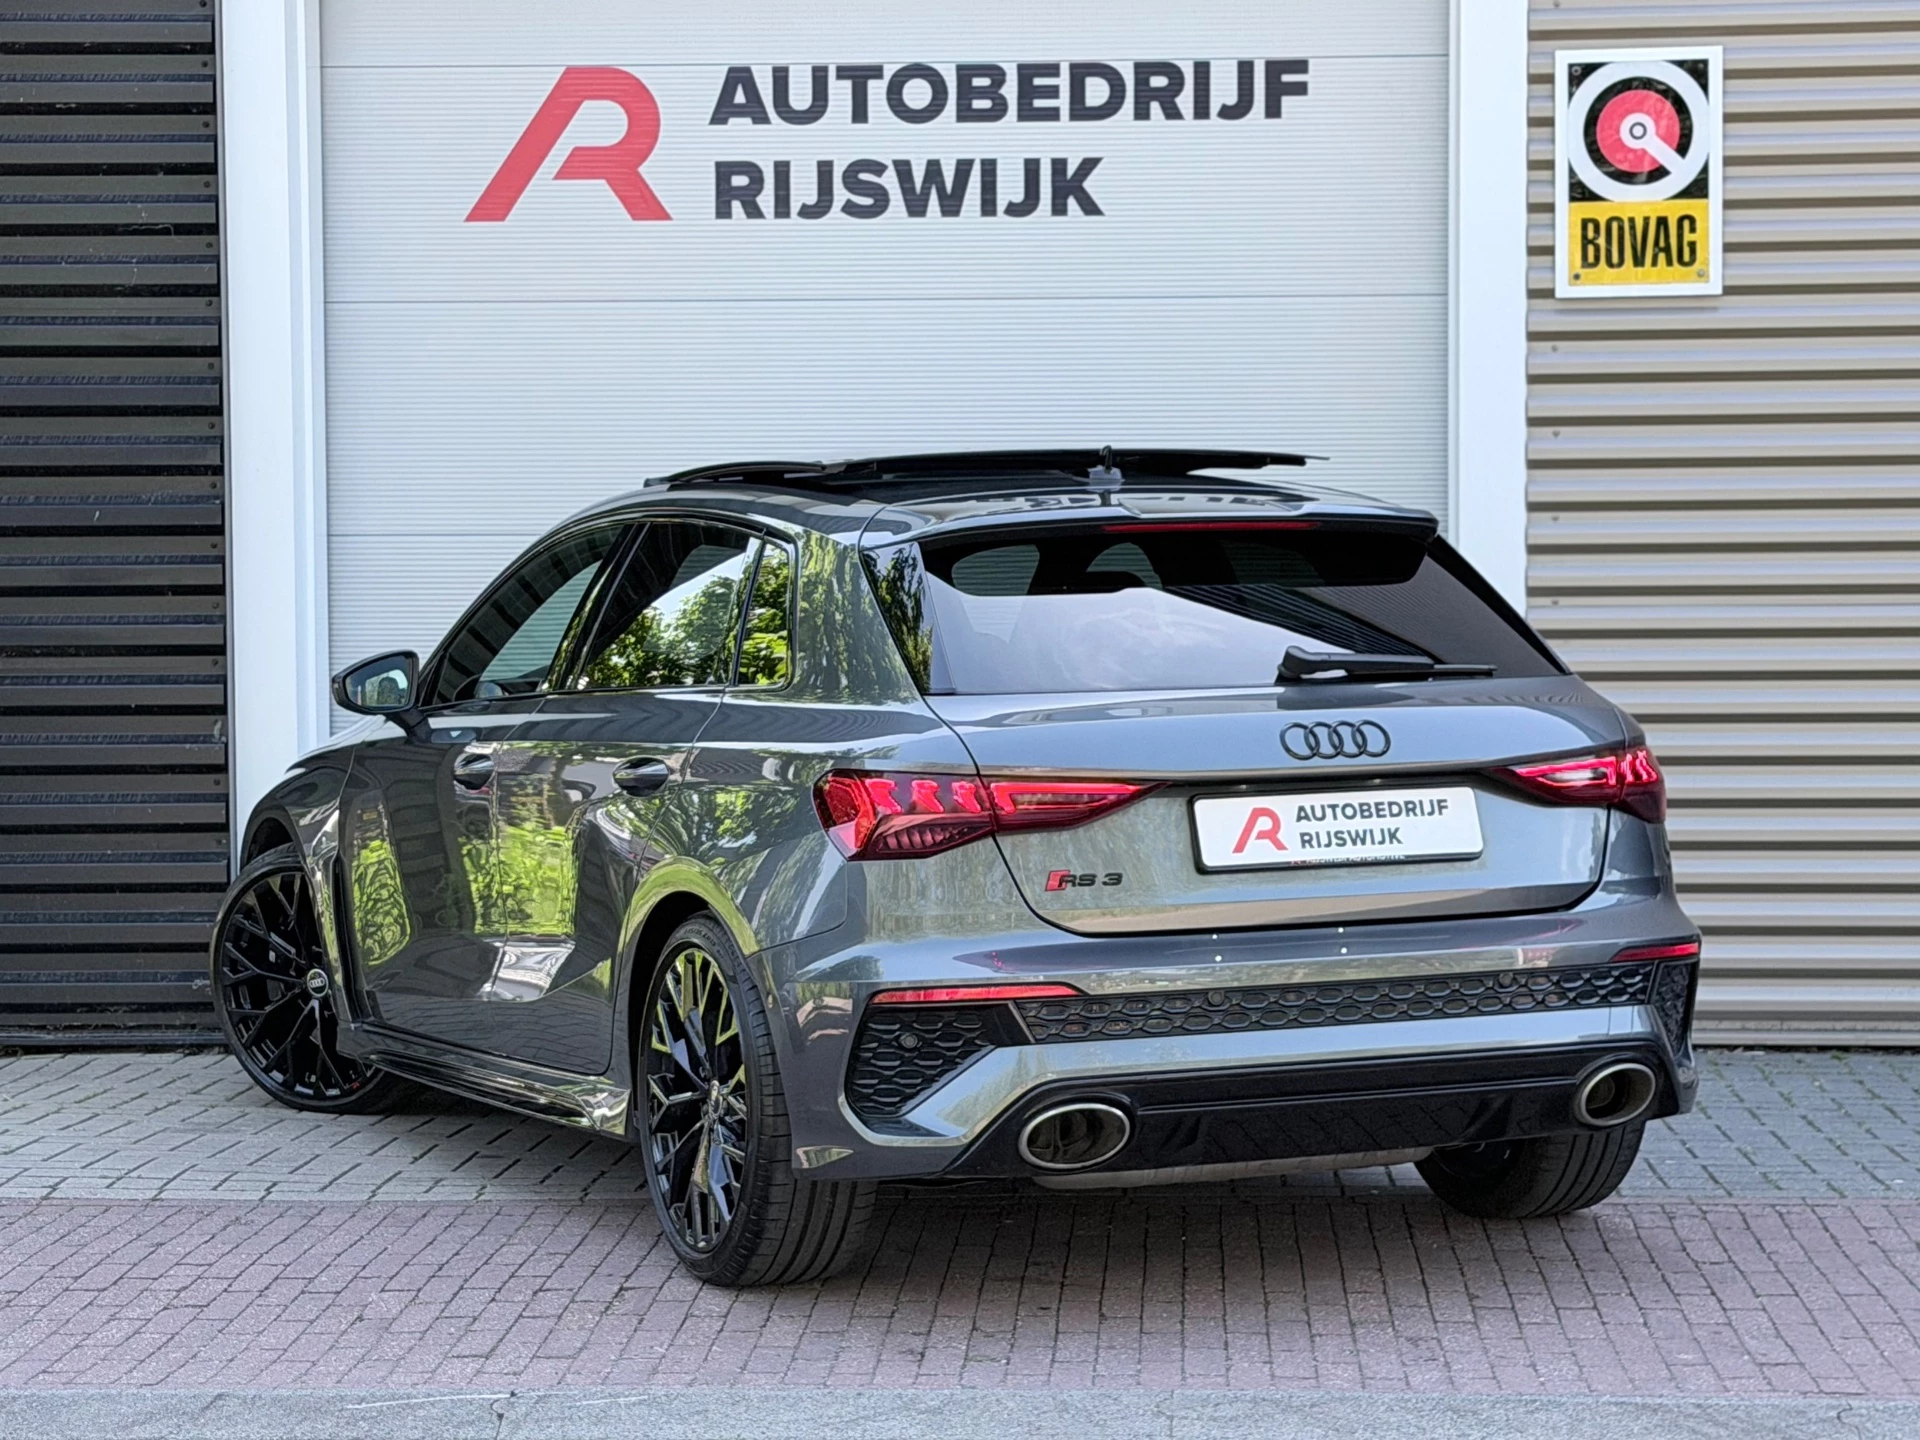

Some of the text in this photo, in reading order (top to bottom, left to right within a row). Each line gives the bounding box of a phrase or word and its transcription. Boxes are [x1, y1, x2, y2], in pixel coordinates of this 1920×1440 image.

[708, 59, 1309, 125] AUTOBEDRIJF
[714, 157, 1105, 220] RIJSWIJK
[1580, 214, 1697, 269] BOVAG
[1295, 799, 1449, 823] AUTOBEDRIJF
[1299, 827, 1403, 849] RIJSWIJK
